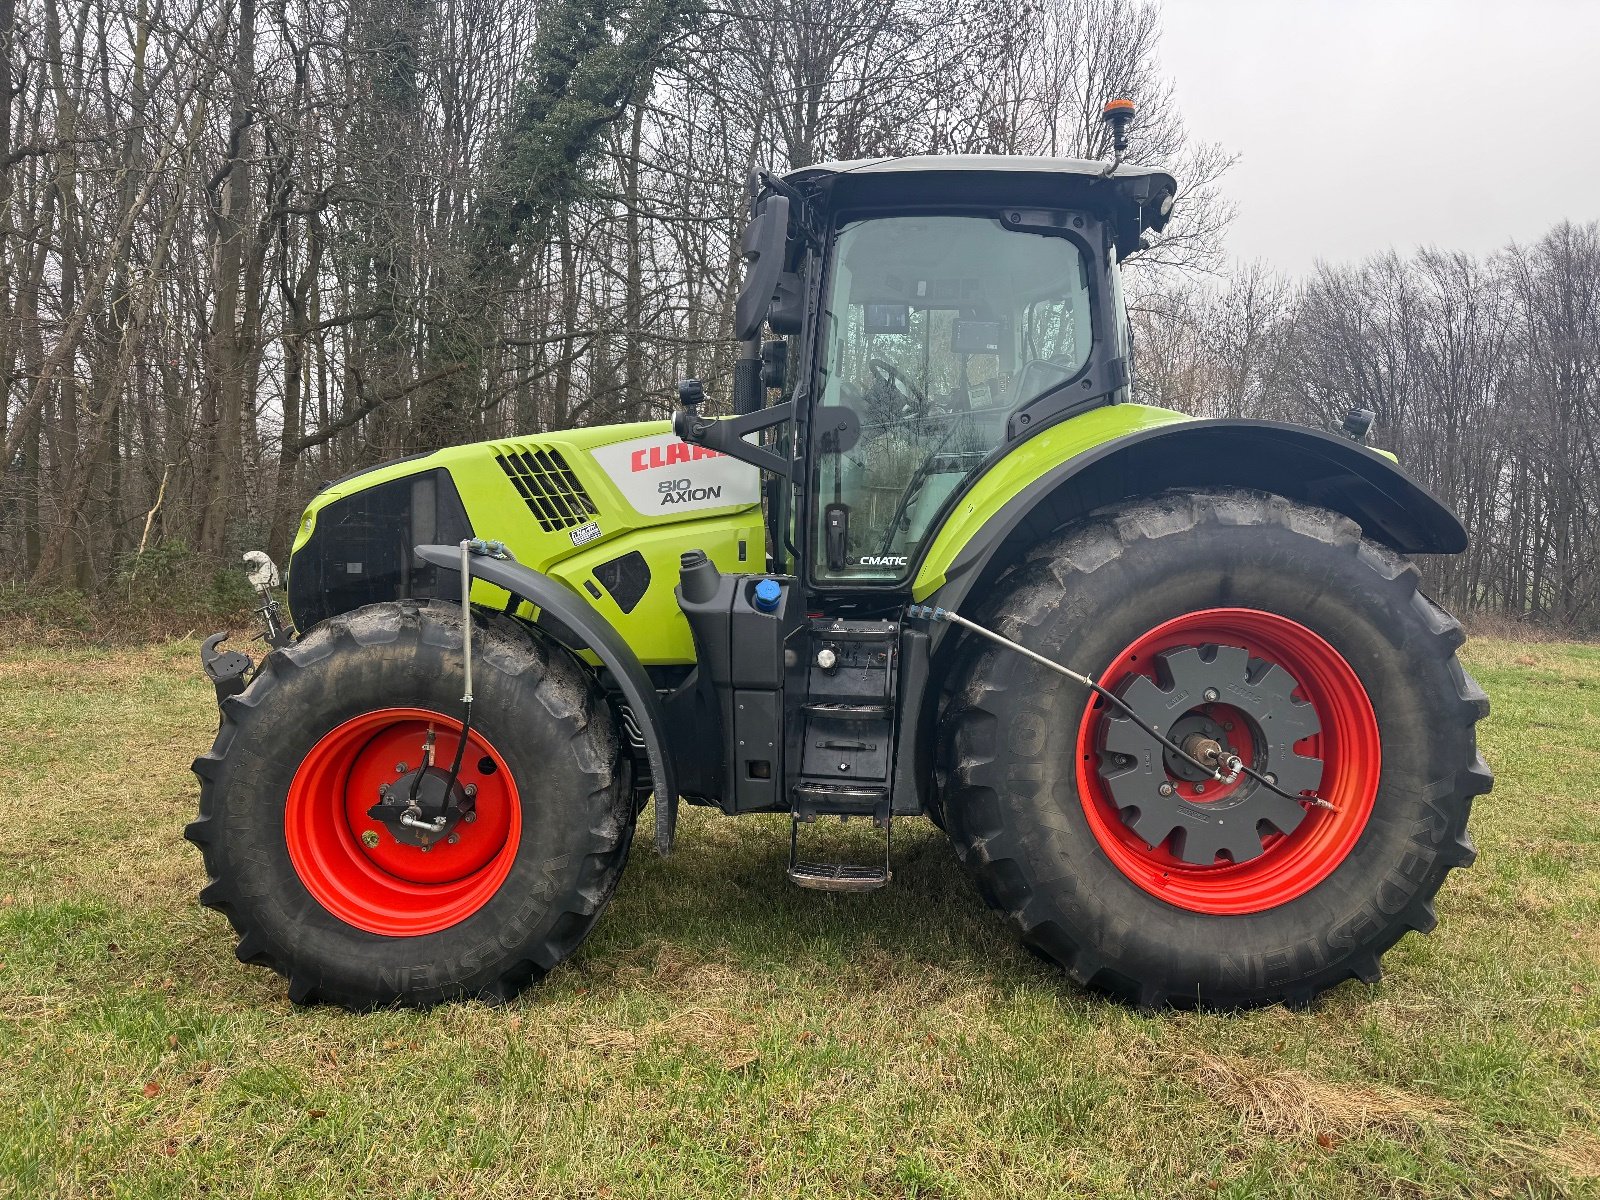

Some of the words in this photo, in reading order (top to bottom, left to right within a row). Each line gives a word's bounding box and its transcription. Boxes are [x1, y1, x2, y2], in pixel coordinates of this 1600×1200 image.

[632, 442, 727, 472] CLAA
[658, 479, 691, 494] 810
[661, 486, 721, 505] AXION
[860, 556, 908, 566] CMATIC
[1218, 772, 1456, 989] VREDESTEIN
[376, 852, 572, 993] VREDESTEIN
